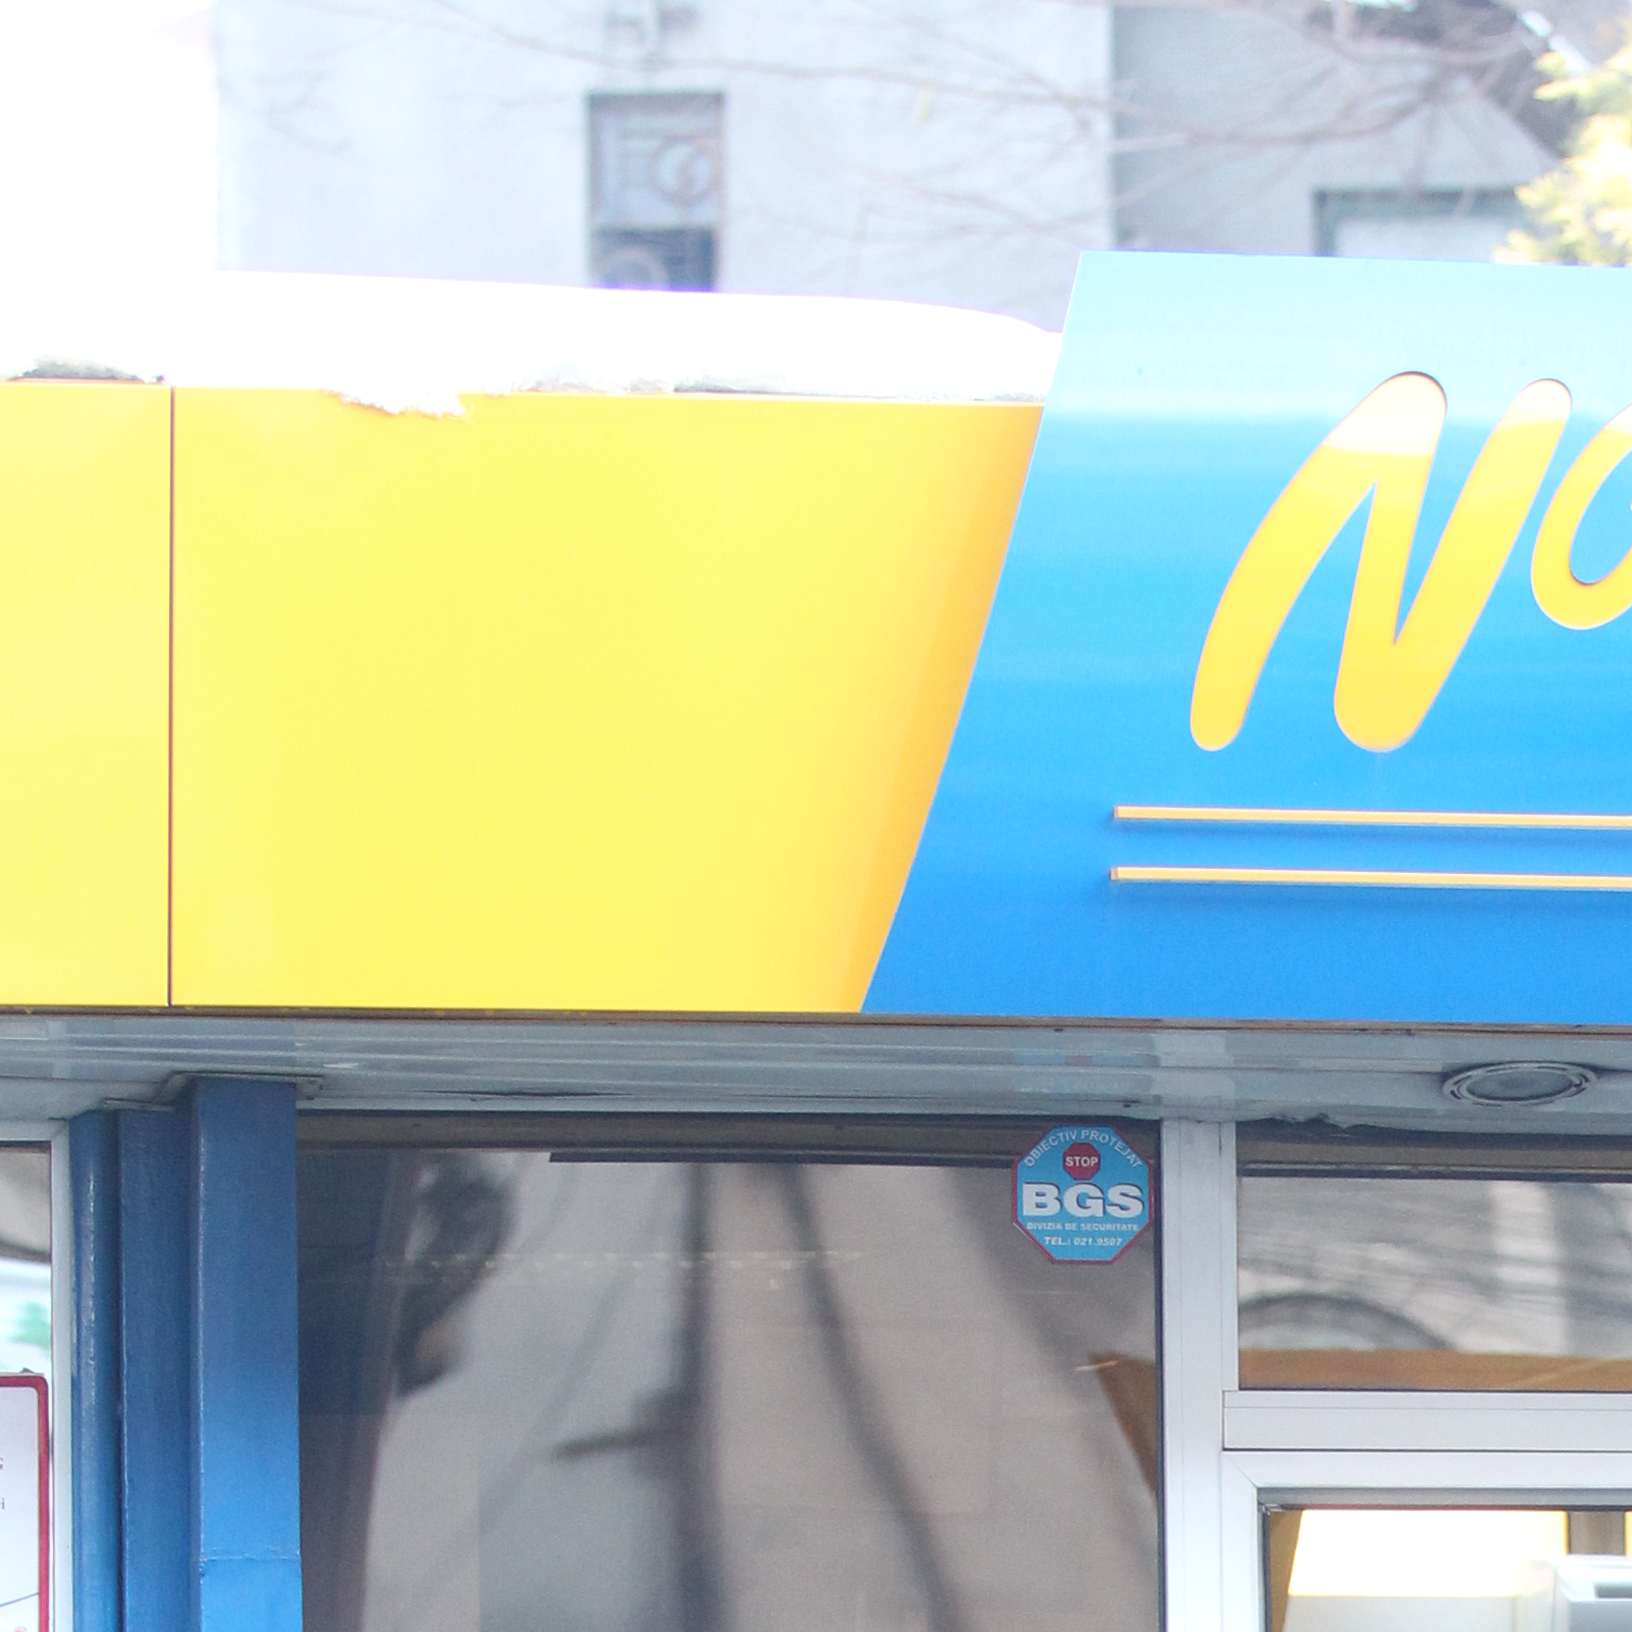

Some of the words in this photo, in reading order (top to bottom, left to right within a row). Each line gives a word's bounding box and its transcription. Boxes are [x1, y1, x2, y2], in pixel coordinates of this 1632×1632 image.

[1024, 1130, 1077, 1167] OBIECTIV
[1081, 1129, 1142, 1168] PROTEJAT
[1066, 1156, 1098, 1167] STOP
[1022, 1181, 1144, 1218] BGS
[1081, 1223, 1139, 1231] SECURITATE
